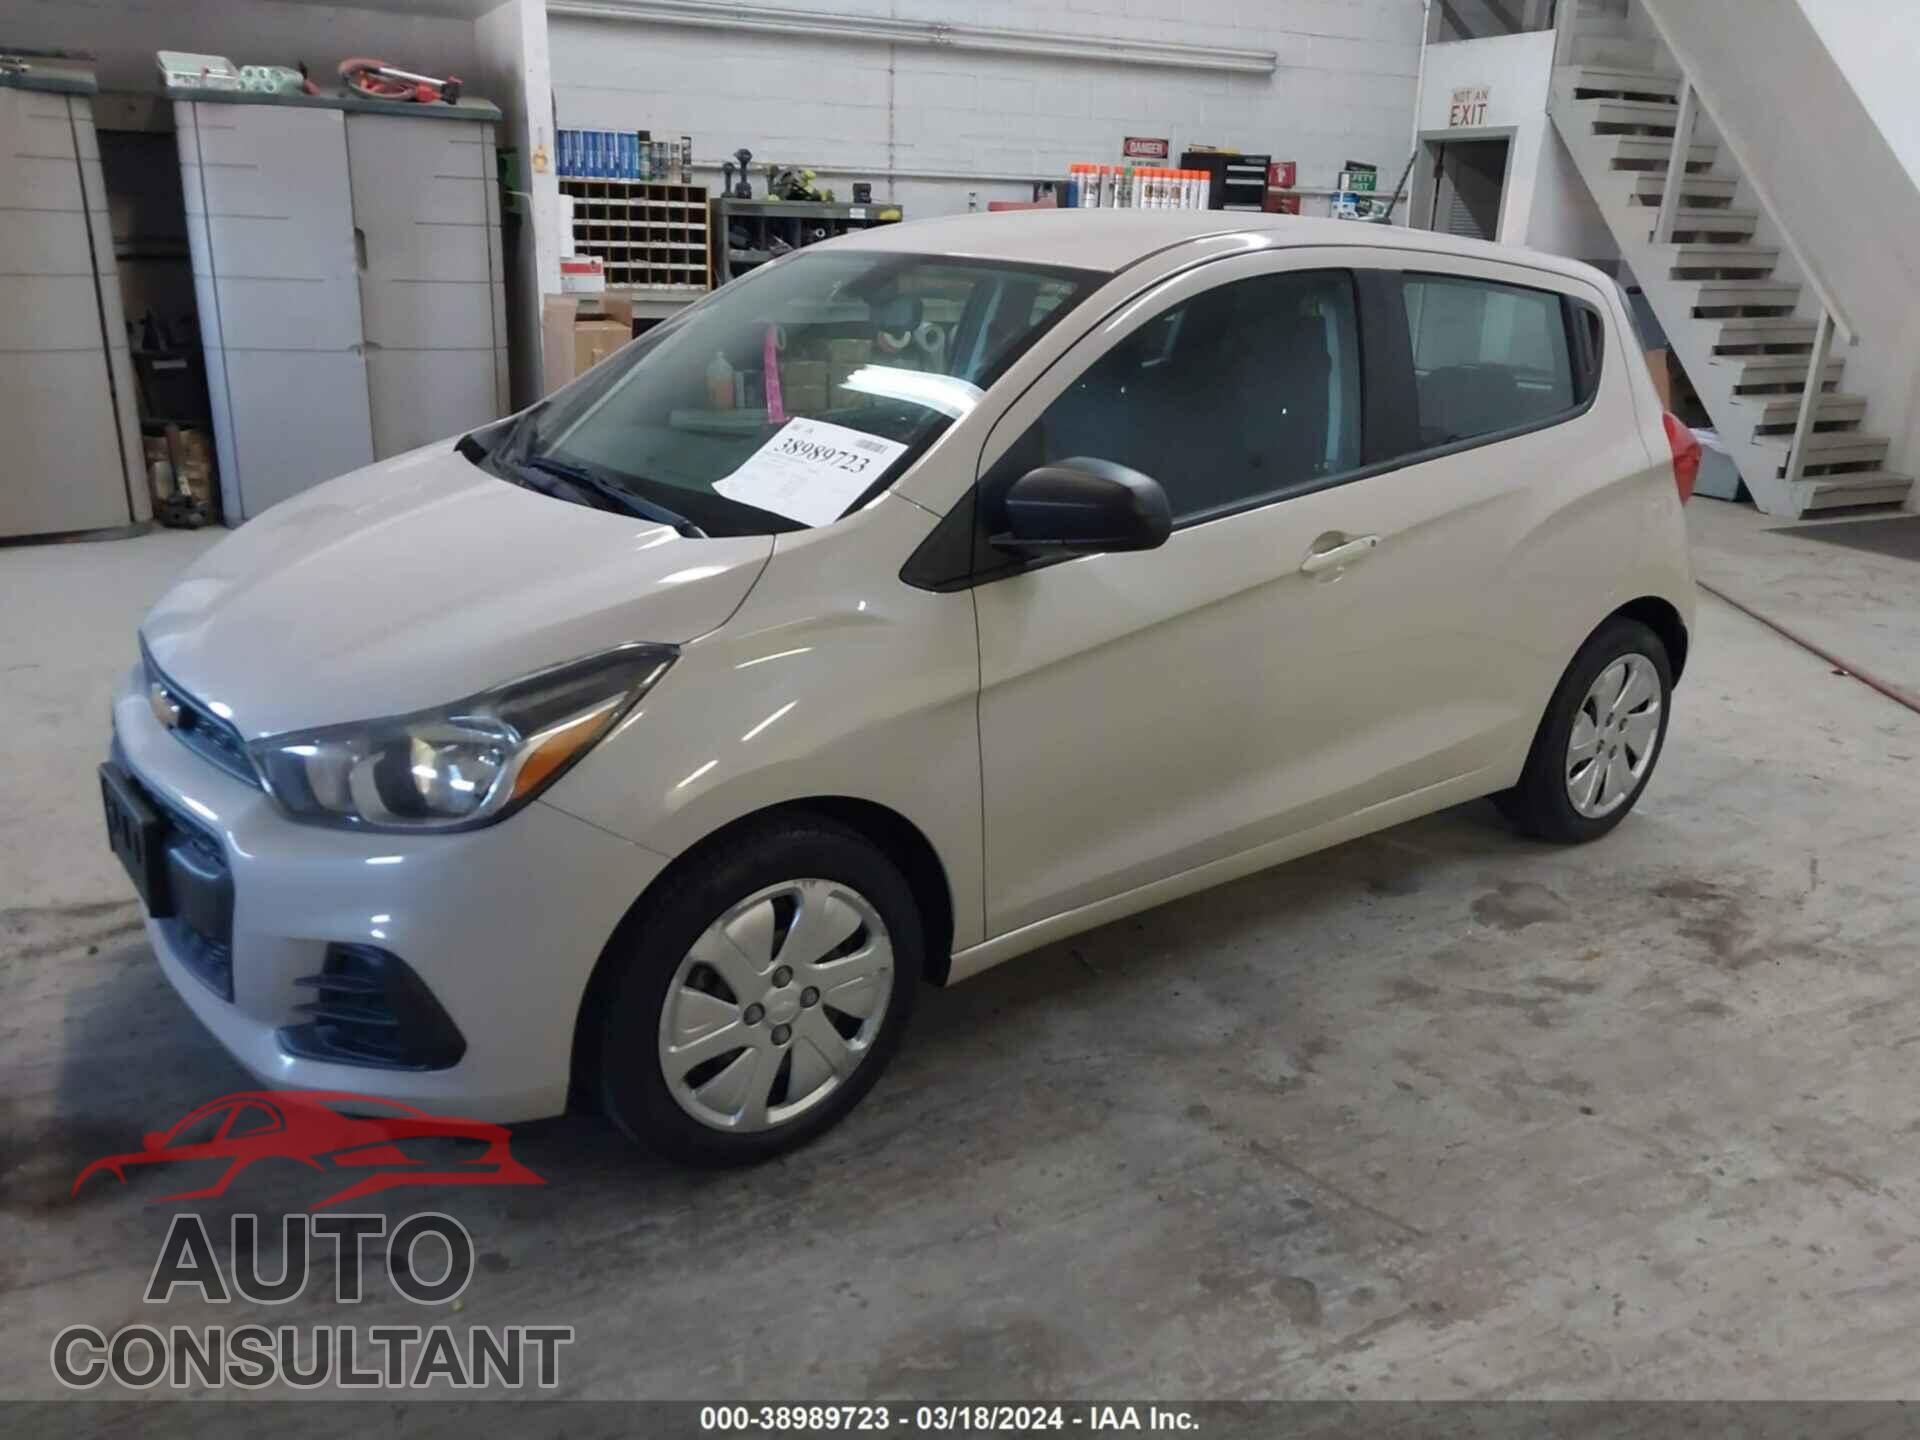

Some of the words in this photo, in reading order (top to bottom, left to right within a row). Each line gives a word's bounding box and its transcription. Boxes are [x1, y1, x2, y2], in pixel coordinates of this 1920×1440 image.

[1449, 103, 1487, 126] EXIT
[1129, 141, 1163, 155] DANGER
[773, 437, 871, 473] 38989723
